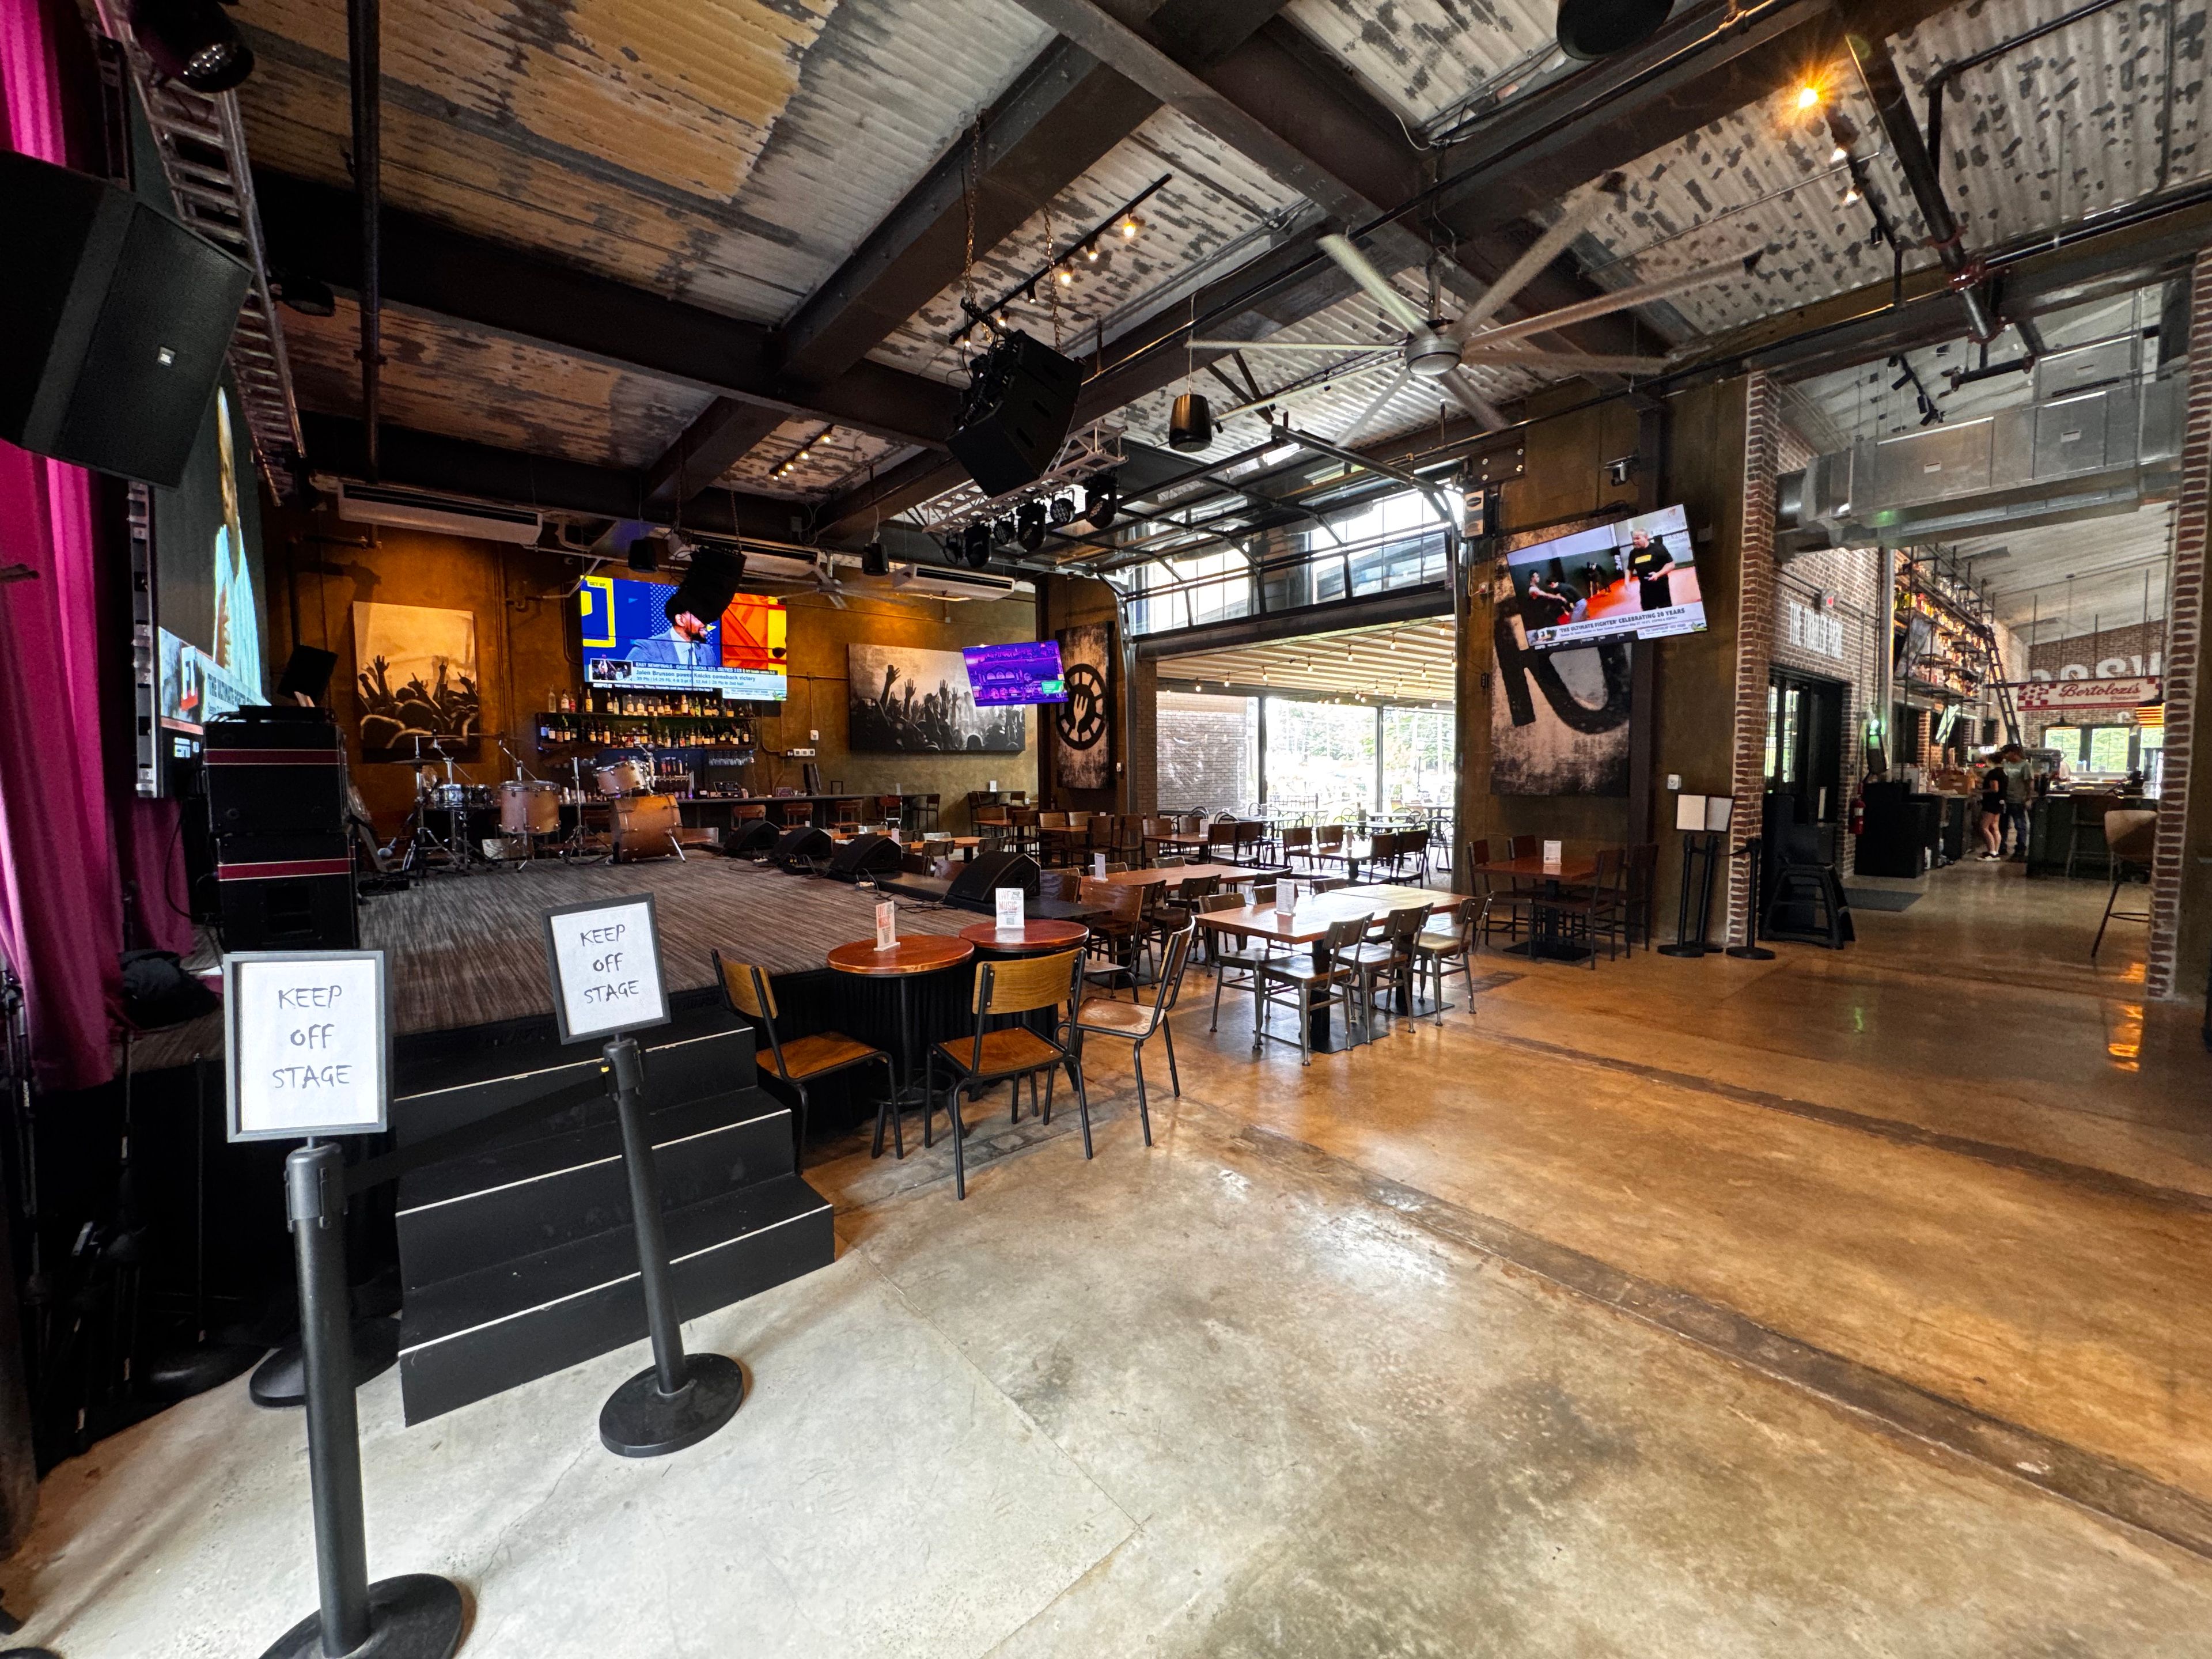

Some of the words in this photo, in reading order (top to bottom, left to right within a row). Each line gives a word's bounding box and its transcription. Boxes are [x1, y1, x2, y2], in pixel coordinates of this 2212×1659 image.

[1571, 623, 1594, 632] ULTIMATE
[1618, 612, 1656, 623] CELEBRATING
[1665, 608, 1685, 616] YEARS
[998, 900, 1018, 911] MUSIC
[580, 924, 626, 945] KEEP
[593, 953, 624, 973] OFF
[278, 984, 343, 1010] KEEP
[584, 980, 640, 1005] STAGE
[290, 1023, 335, 1050] OFF
[272, 1064, 353, 1090] STAGE
